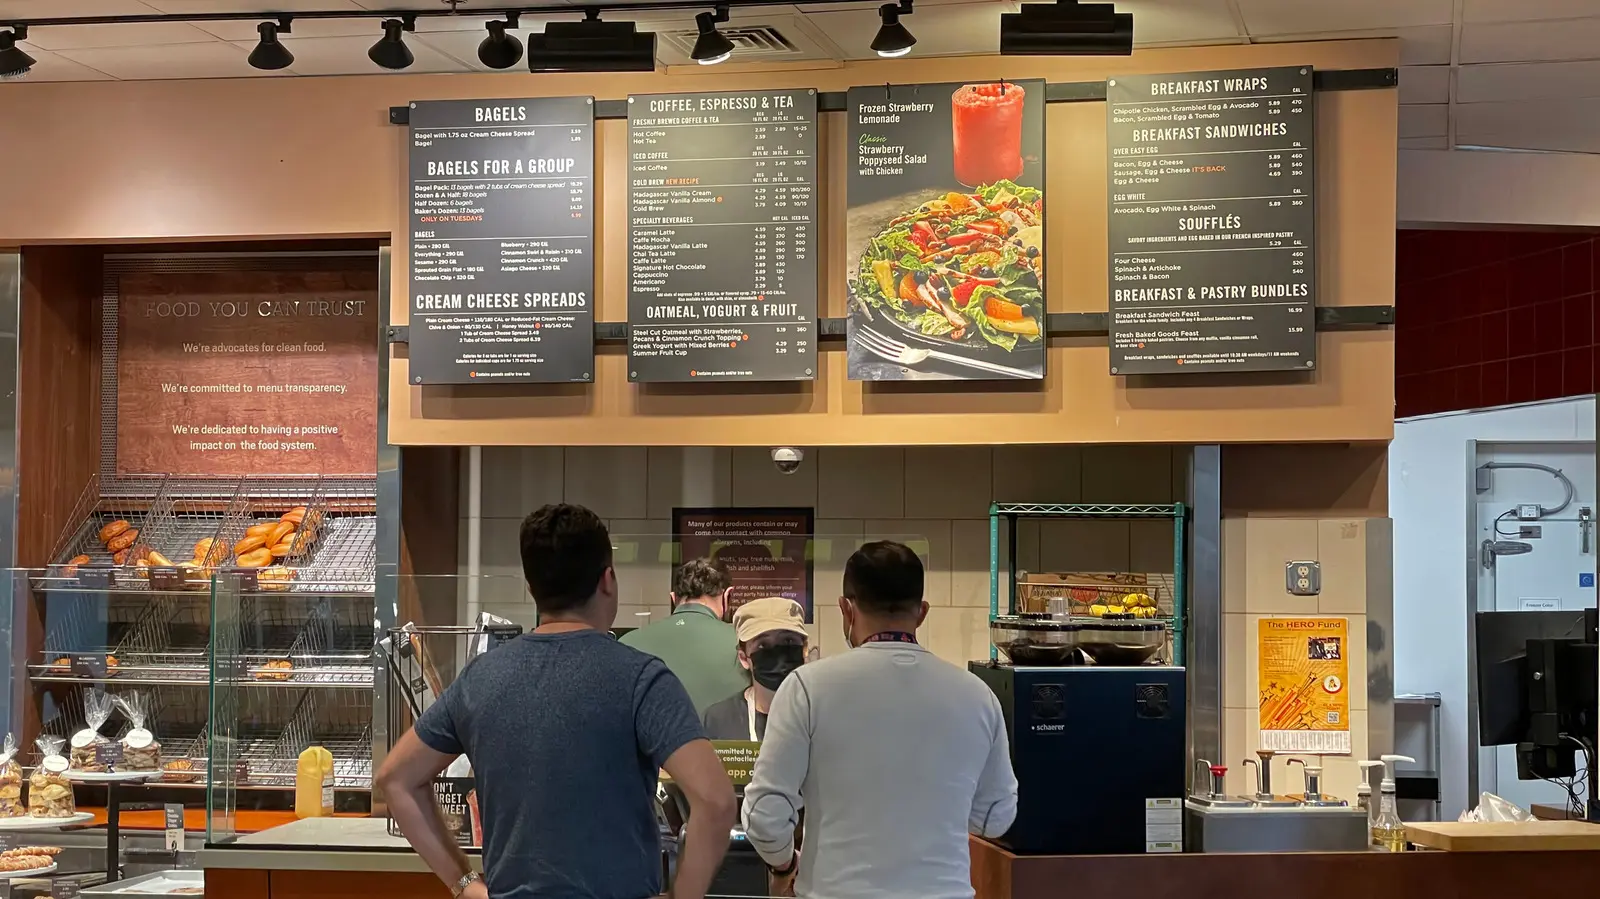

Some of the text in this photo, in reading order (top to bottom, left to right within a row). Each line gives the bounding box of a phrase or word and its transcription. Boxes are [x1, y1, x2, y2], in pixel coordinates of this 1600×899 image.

[1152, 78, 1267, 95] BREAKFAST WRAPS
[650, 96, 793, 112] COFFEE, ESPRESSO & TEA
[860, 103, 933, 113] Frozen Strawberry
[476, 107, 526, 121] BAGELS
[859, 114, 900, 124] Lemonade
[1134, 123, 1286, 141] BREAKFAST SANDWICHES
[859, 134, 887, 144] Classic
[859, 145, 904, 154] Strawberry
[859, 155, 927, 166] Poppyseed Salad
[428, 159, 574, 175] BAGELS FOR A GROUP
[1179, 214, 1240, 230] SOUFFLÉS
[1115, 284, 1307, 301] BREAKFAST & PASTRY BUNDLES
[416, 292, 585, 309] CREAM CHEESE SPREADS
[147, 301, 365, 317] FOOD YOU CAN TRUST
[647, 304, 797, 318] OATMEAL, YOGURT & FRUIT
[183, 342, 326, 352] We're advocates for clean food.
[162, 384, 188, 392] We're
[190, 383, 240, 392] committed
[243, 384, 252, 392] to
[286, 384, 347, 394] transparency.
[172, 425, 199, 434] We're
[201, 425, 247, 434] dedicated
[249, 426, 259, 436] to
[261, 424, 292, 436] having
[302, 425, 338, 436] positive
[190, 440, 316, 452] impact on the food system.
[728, 770, 746, 778] app
[433, 782, 453, 793] ON'T
[440, 804, 466, 814] WEET
